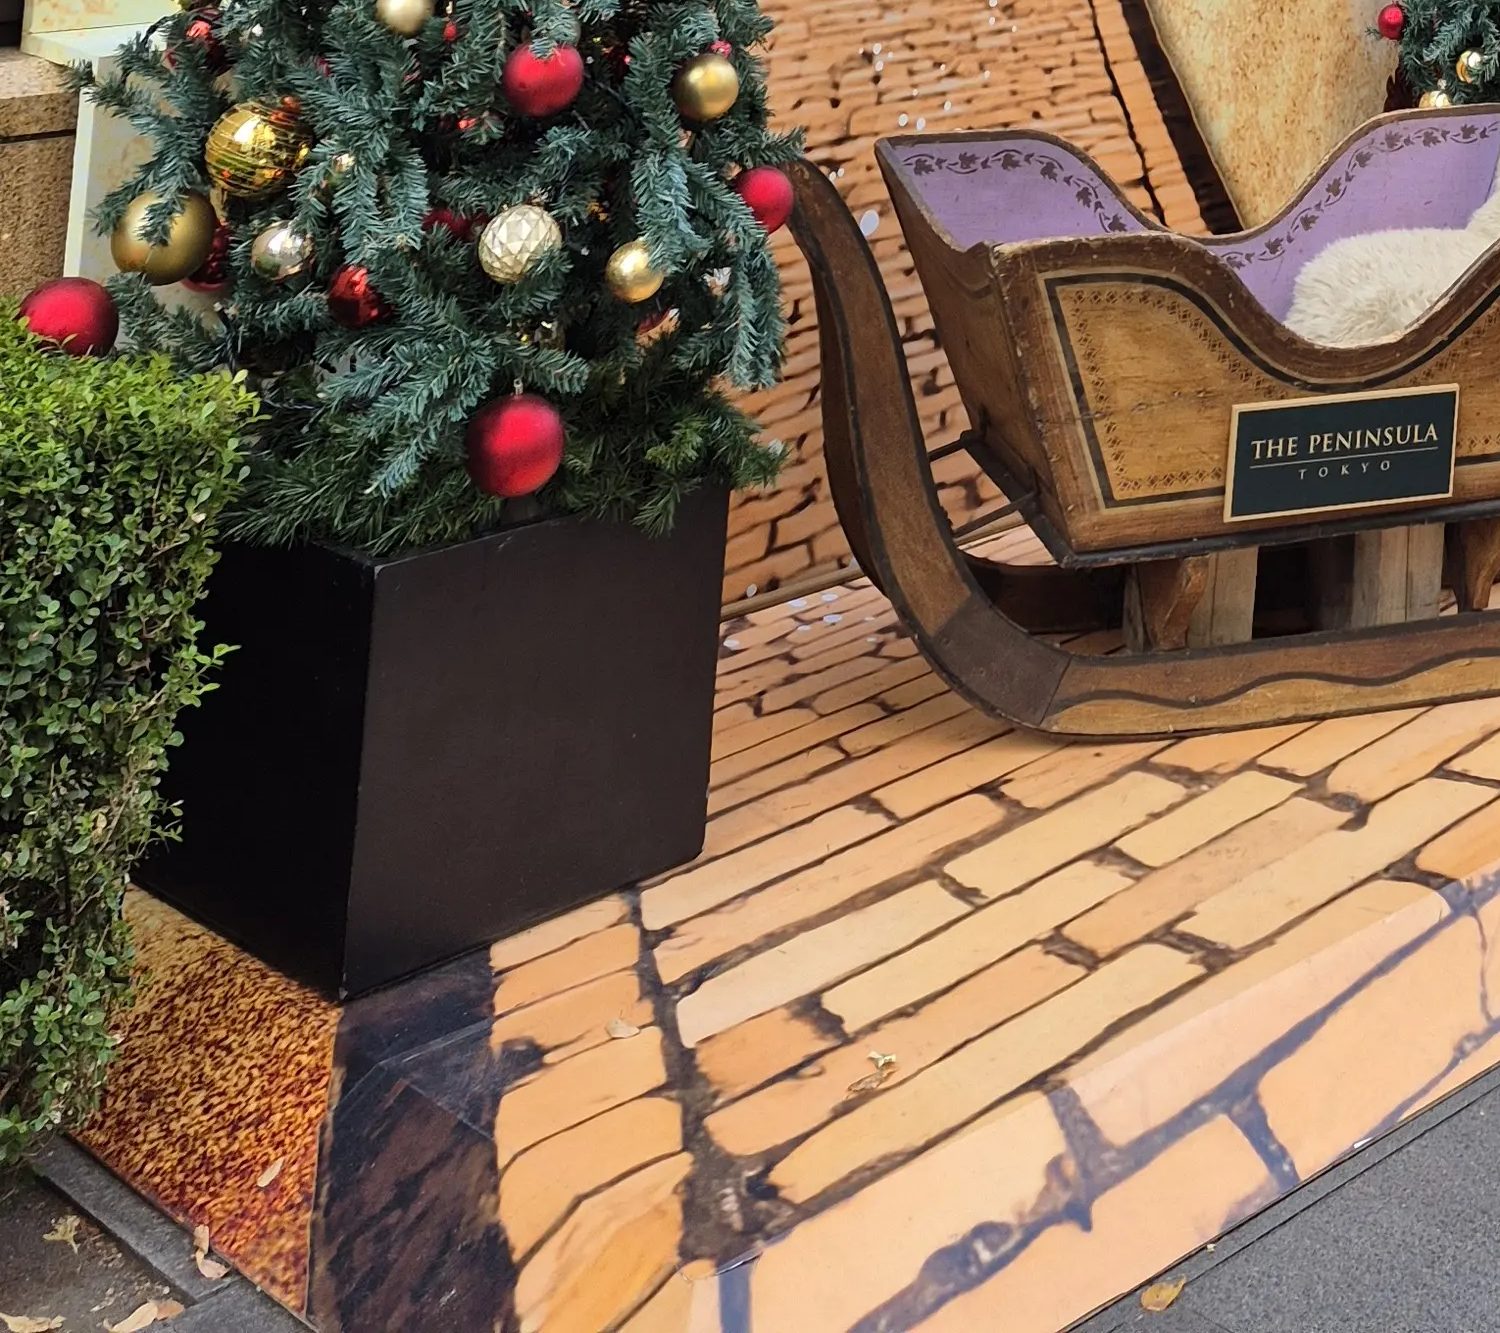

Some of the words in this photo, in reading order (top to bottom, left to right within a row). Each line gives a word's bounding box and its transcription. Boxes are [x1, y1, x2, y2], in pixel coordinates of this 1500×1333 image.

[1250, 436, 1298, 460] THE
[1308, 422, 1439, 454] PENINSULA
[1298, 459, 1391, 480] TOKYO
